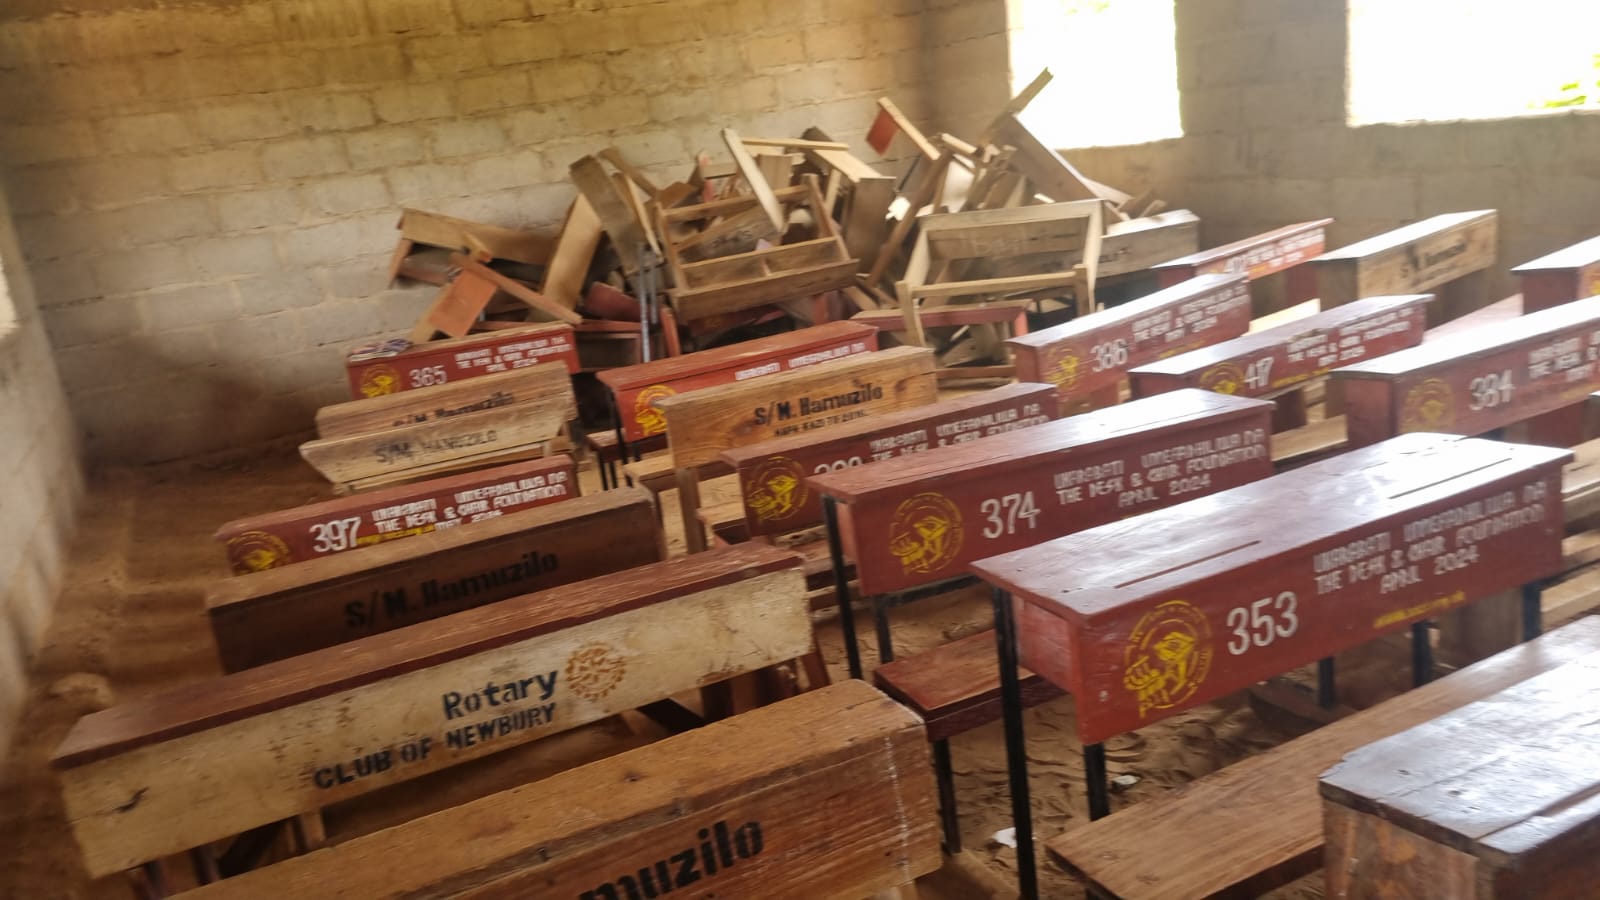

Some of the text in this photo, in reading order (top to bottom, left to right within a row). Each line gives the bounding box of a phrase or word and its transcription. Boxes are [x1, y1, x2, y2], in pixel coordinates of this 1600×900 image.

[409, 365, 448, 388] 365
[1469, 369, 1516, 410] 384
[1169, 473, 1210, 495] 2024
[309, 516, 362, 552] 397
[980, 491, 1041, 539] 374
[1314, 570, 1343, 594] THE
[1380, 545, 1480, 594] APRIL 2024
[1227, 591, 1298, 655] 353
[442, 670, 558, 721] Rotary
[313, 702, 557, 789] CLUB OF NEWBURY
[578, 820, 764, 900] muzilo
